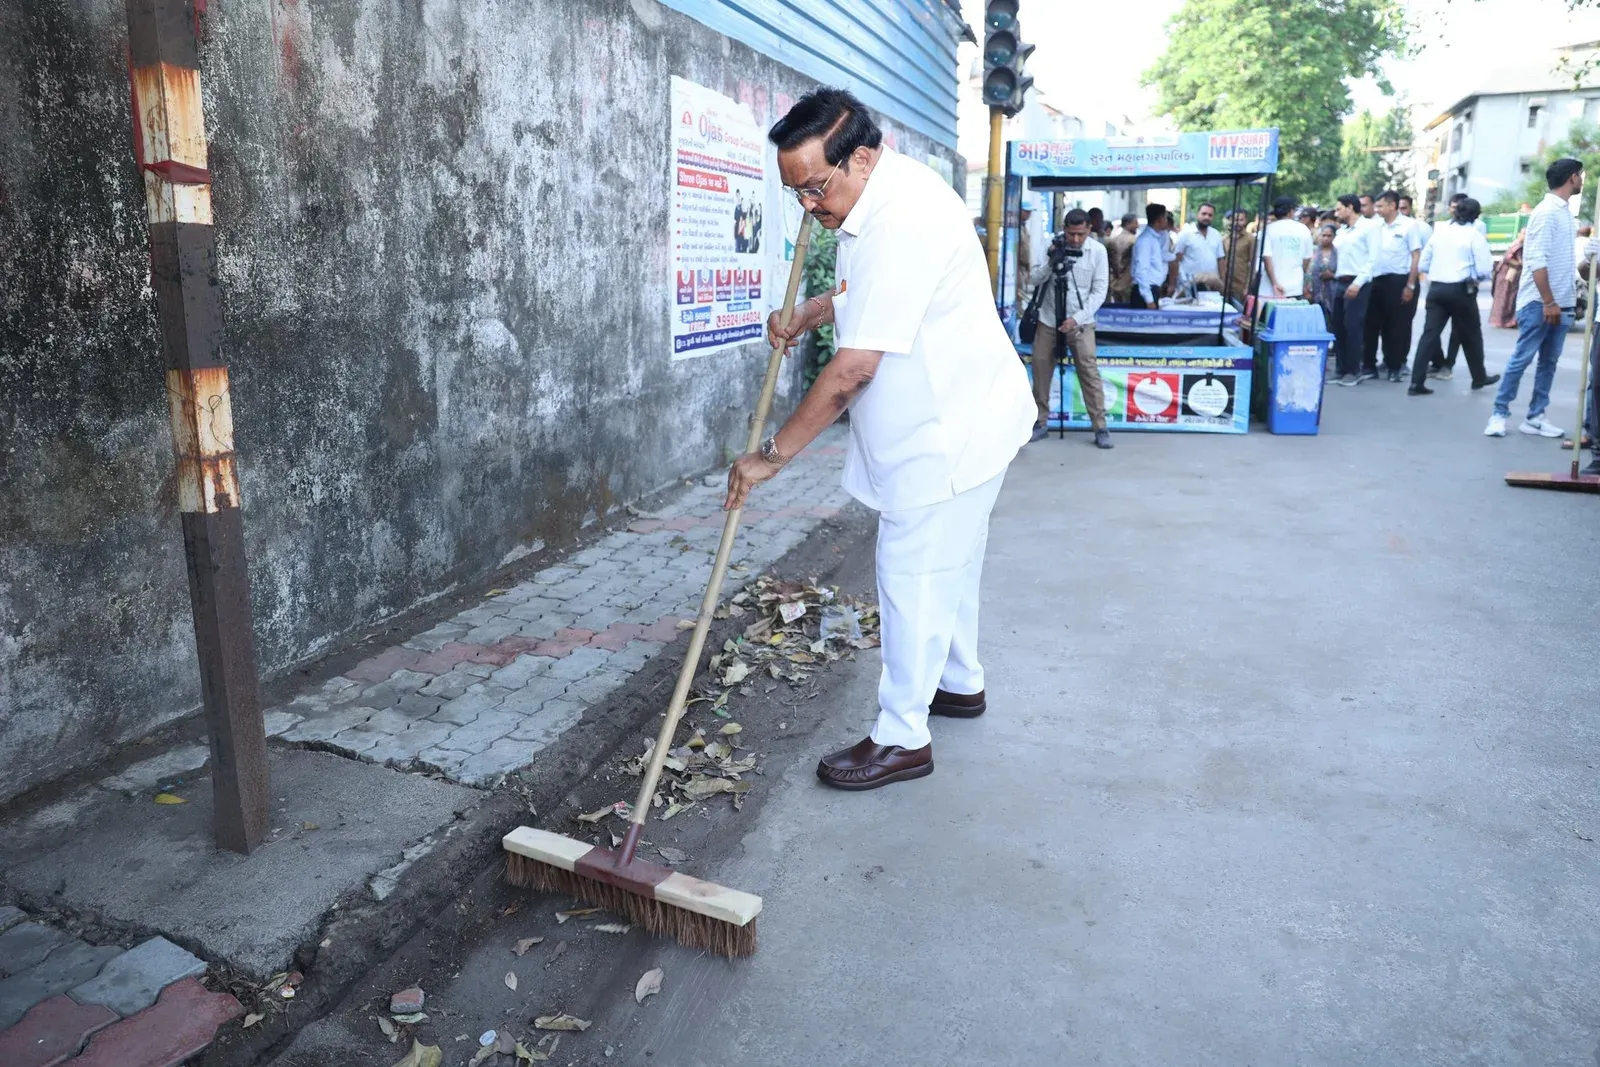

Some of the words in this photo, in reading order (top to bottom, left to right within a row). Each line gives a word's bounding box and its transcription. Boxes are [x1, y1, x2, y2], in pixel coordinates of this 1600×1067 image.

[699, 113, 723, 144] Ojas
[1210, 136, 1239, 158] MY
[1241, 133, 1269, 146] SURAT
[1090, 154, 1113, 166] સુરત
[1117, 149, 1195, 164] મહાનગરપાલિકા
[1238, 146, 1264, 159] PRIDE
[679, 171, 695, 185] Shree
[696, 173, 708, 187] Ojas
